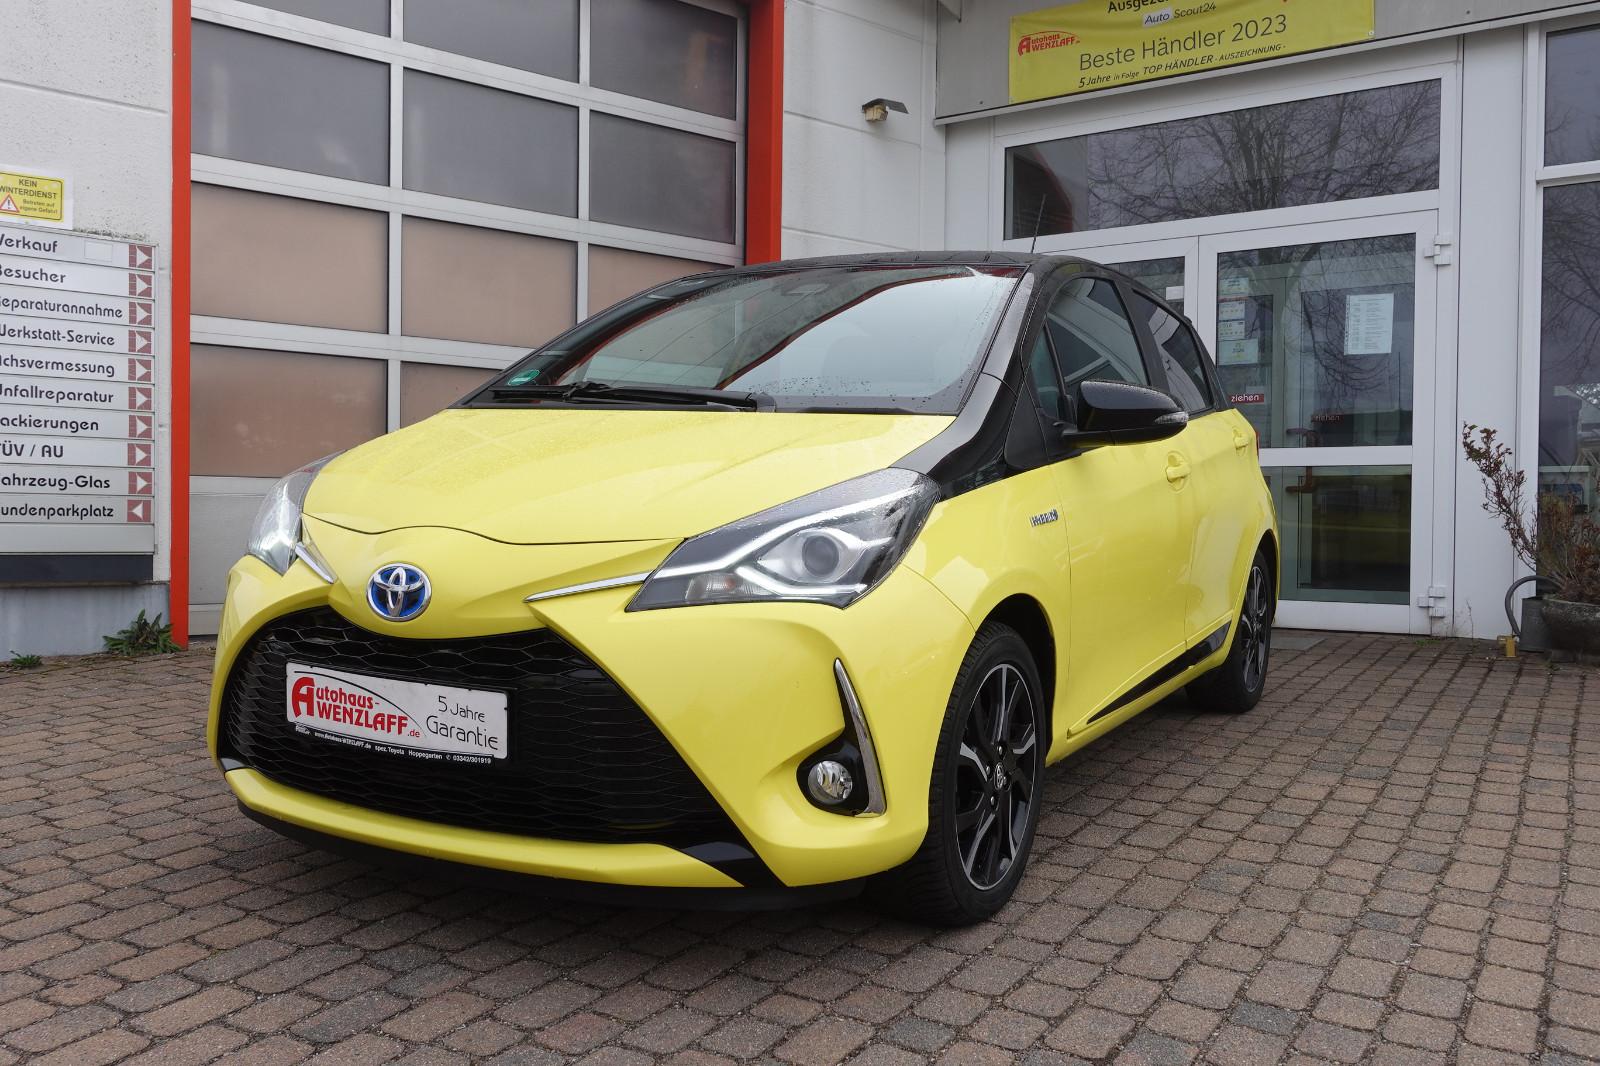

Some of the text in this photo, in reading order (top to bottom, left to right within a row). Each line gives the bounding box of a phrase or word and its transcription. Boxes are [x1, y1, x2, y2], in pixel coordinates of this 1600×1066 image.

[1107, 0, 1169, 14] Ausgez
[1145, 4, 1217, 25] Auto Scout24
[1079, 14, 1287, 71] Beste Händler 2023
[1078, 77, 1086, 88] 5
[1086, 74, 1112, 86] Jahre
[1121, 71, 1140, 80] Folge
[1143, 64, 1164, 76] TOP
[1165, 54, 1214, 71] HÄNDLER
[1219, 46, 1282, 62] AUSZEICHNUNG
[18, 179, 37, 188] KEIN
[0, 264, 67, 283] esucher
[0, 297, 123, 318] eparaturannahme
[0, 354, 115, 377] chsvermessung
[0, 384, 114, 403] nfallreparatur
[1231, 394, 1260, 402] ziehen
[0, 414, 99, 433] ackierungen
[0, 440, 25, 457] ÜV
[41, 445, 64, 458] AU
[0, 473, 111, 490] ahrzeug-Glas
[0, 503, 114, 520] undenparkplatz
[438, 696, 486, 723] 5 Jahre
[426, 715, 499, 751] Garantie
[388, 746, 405, 754] Toyota
[408, 750, 443, 760] Hoppegarten
